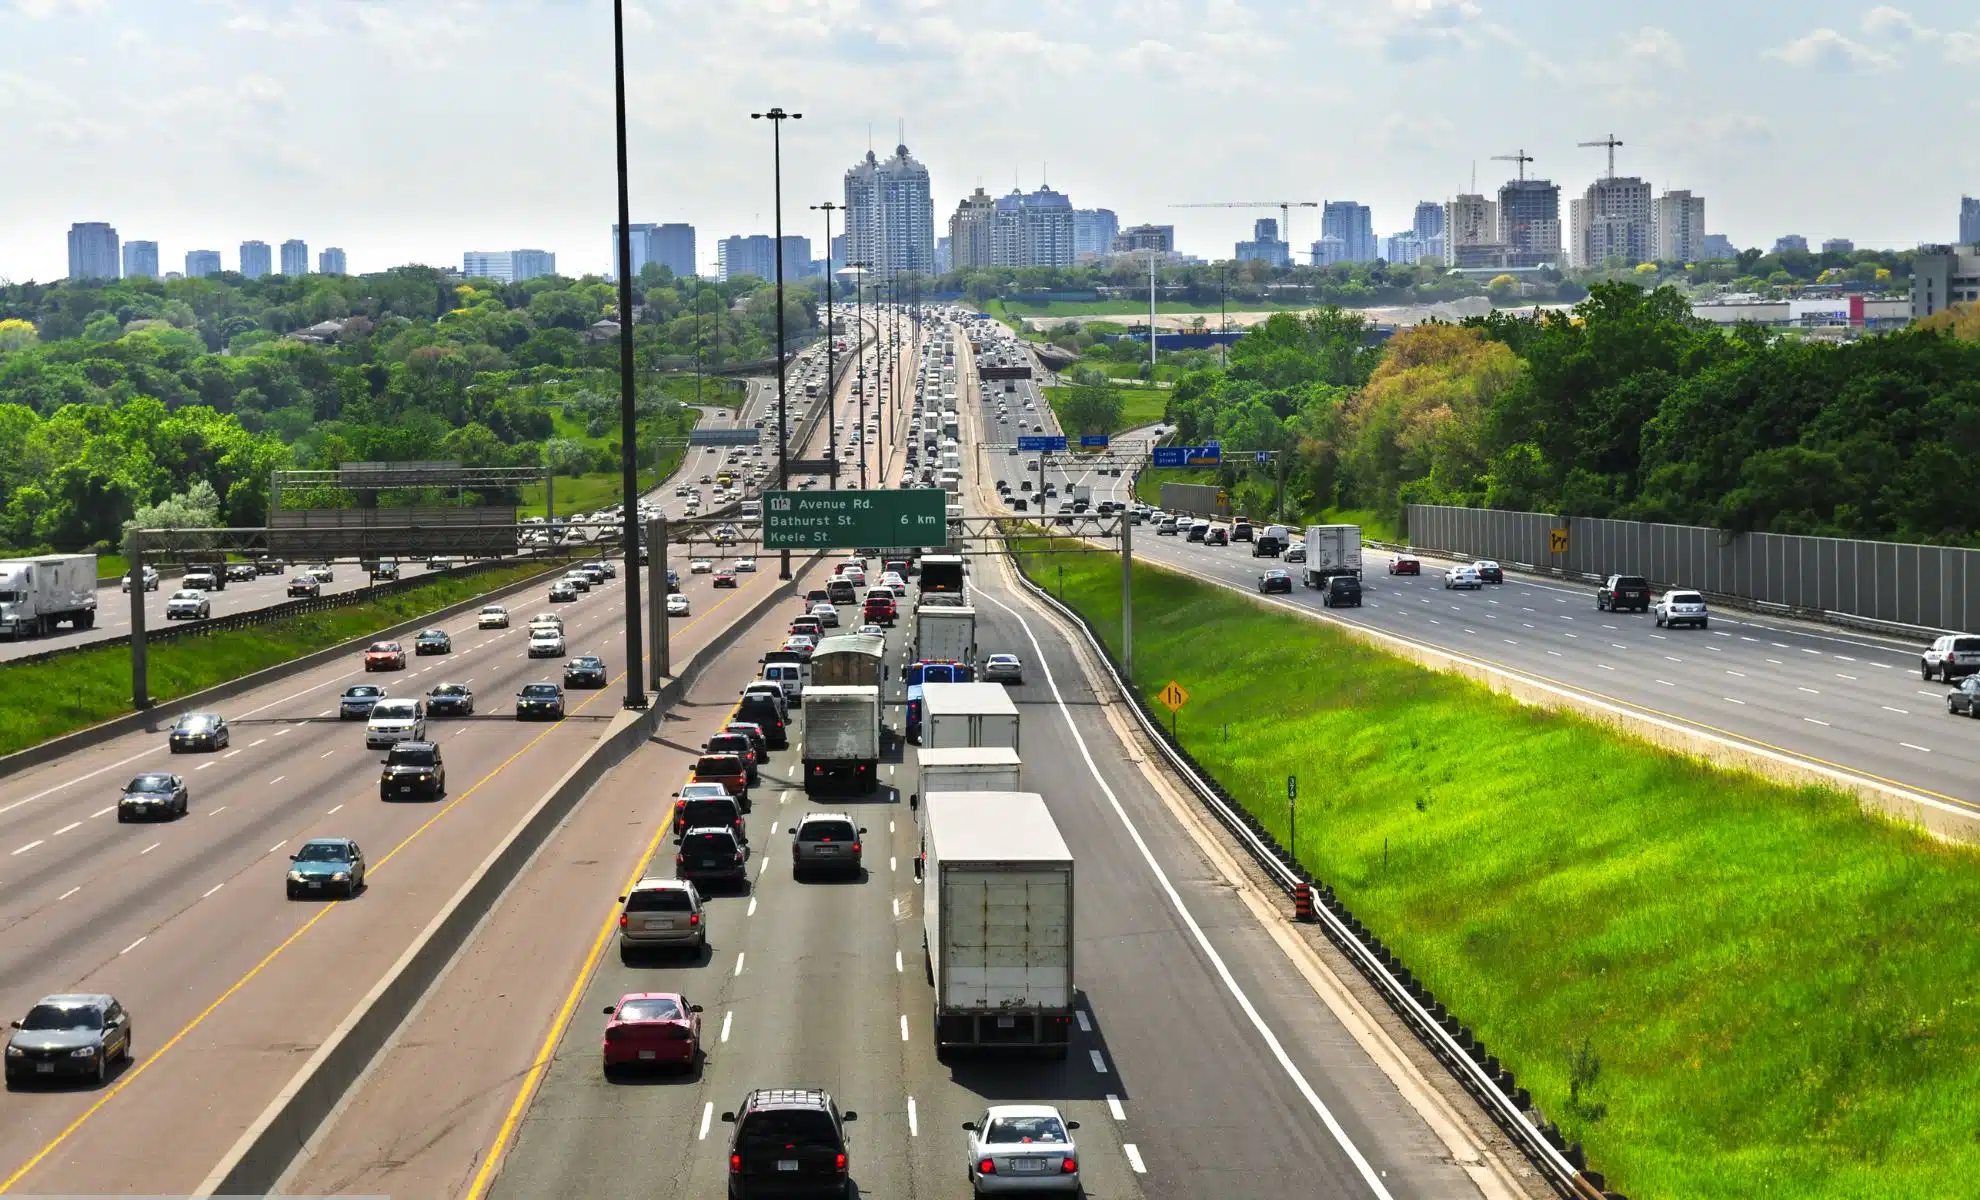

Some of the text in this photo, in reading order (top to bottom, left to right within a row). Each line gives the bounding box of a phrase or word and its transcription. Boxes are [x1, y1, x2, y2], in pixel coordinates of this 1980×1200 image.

[1257, 452, 1266, 462] H
[799, 499, 846, 509] Avenue
[853, 499, 873, 509] Rd.
[770, 516, 855, 526] Bathurst St.
[900, 514, 936, 525] 6 km
[770, 532, 831, 543] Keele St.
